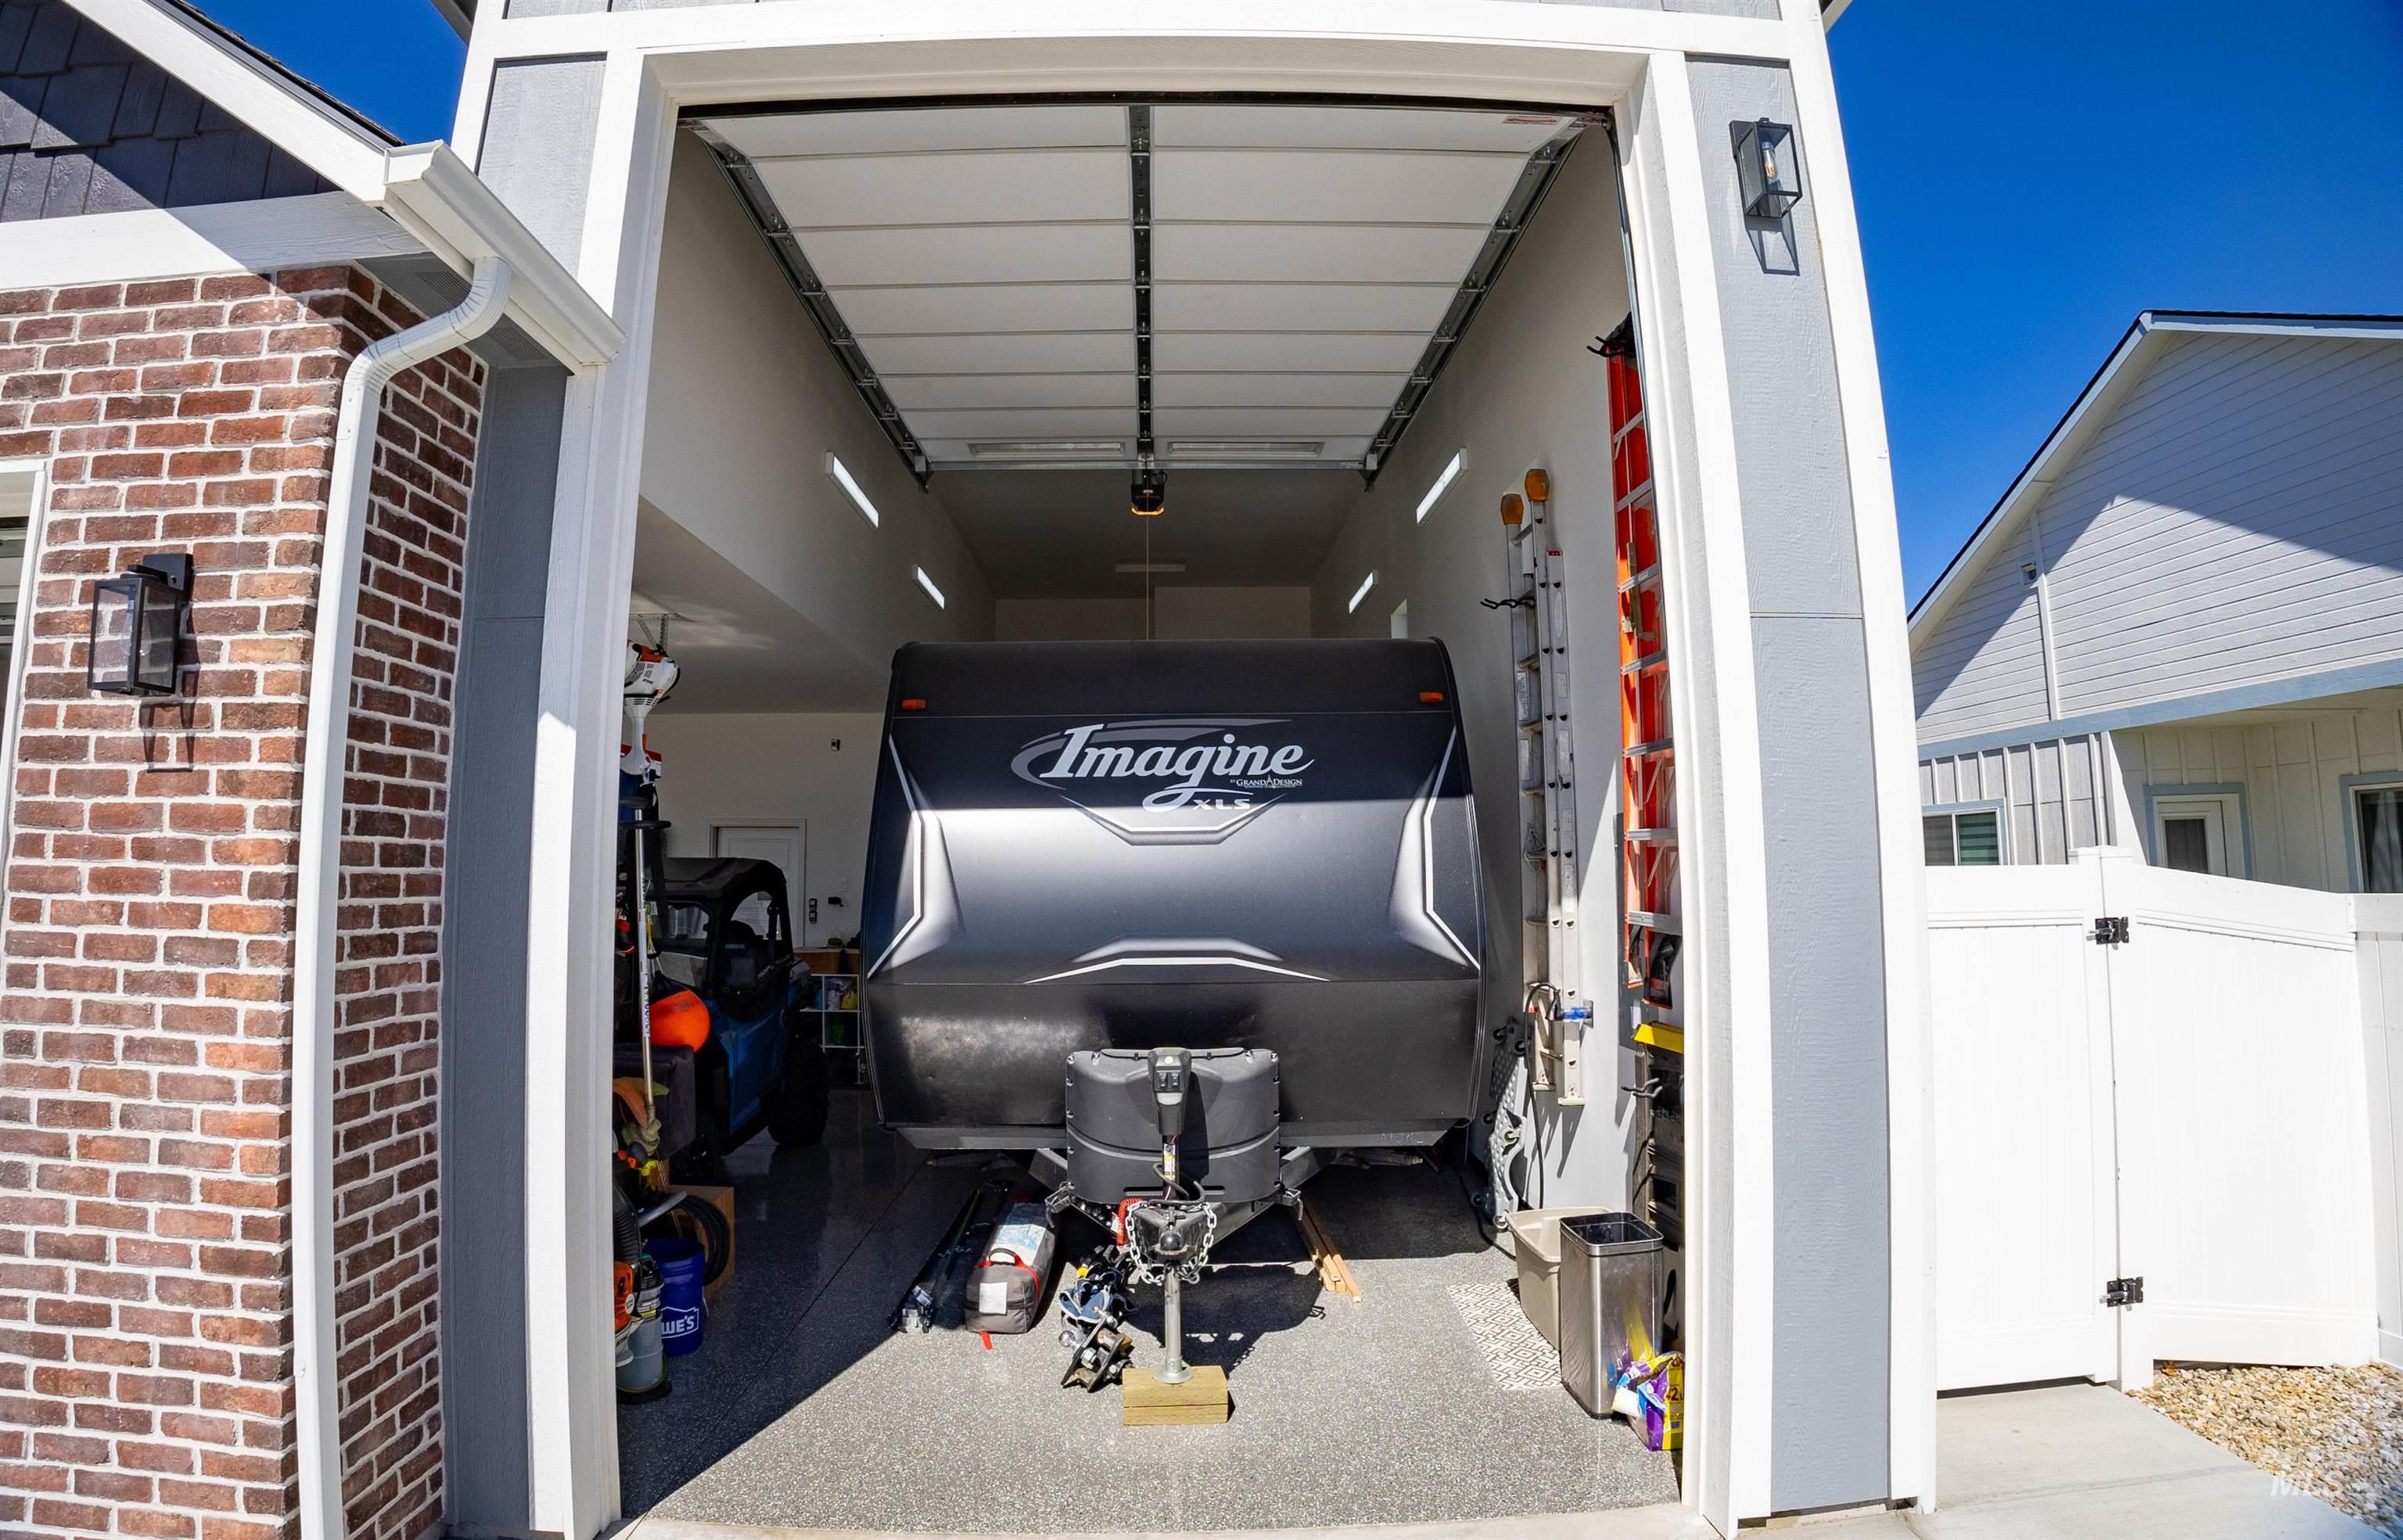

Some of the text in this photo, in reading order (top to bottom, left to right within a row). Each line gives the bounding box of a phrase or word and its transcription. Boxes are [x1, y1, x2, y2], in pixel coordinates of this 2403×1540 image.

[1040, 723, 1314, 812] Imagine
[1192, 798, 1251, 810] XLS
[661, 1316, 695, 1334] WE'S
